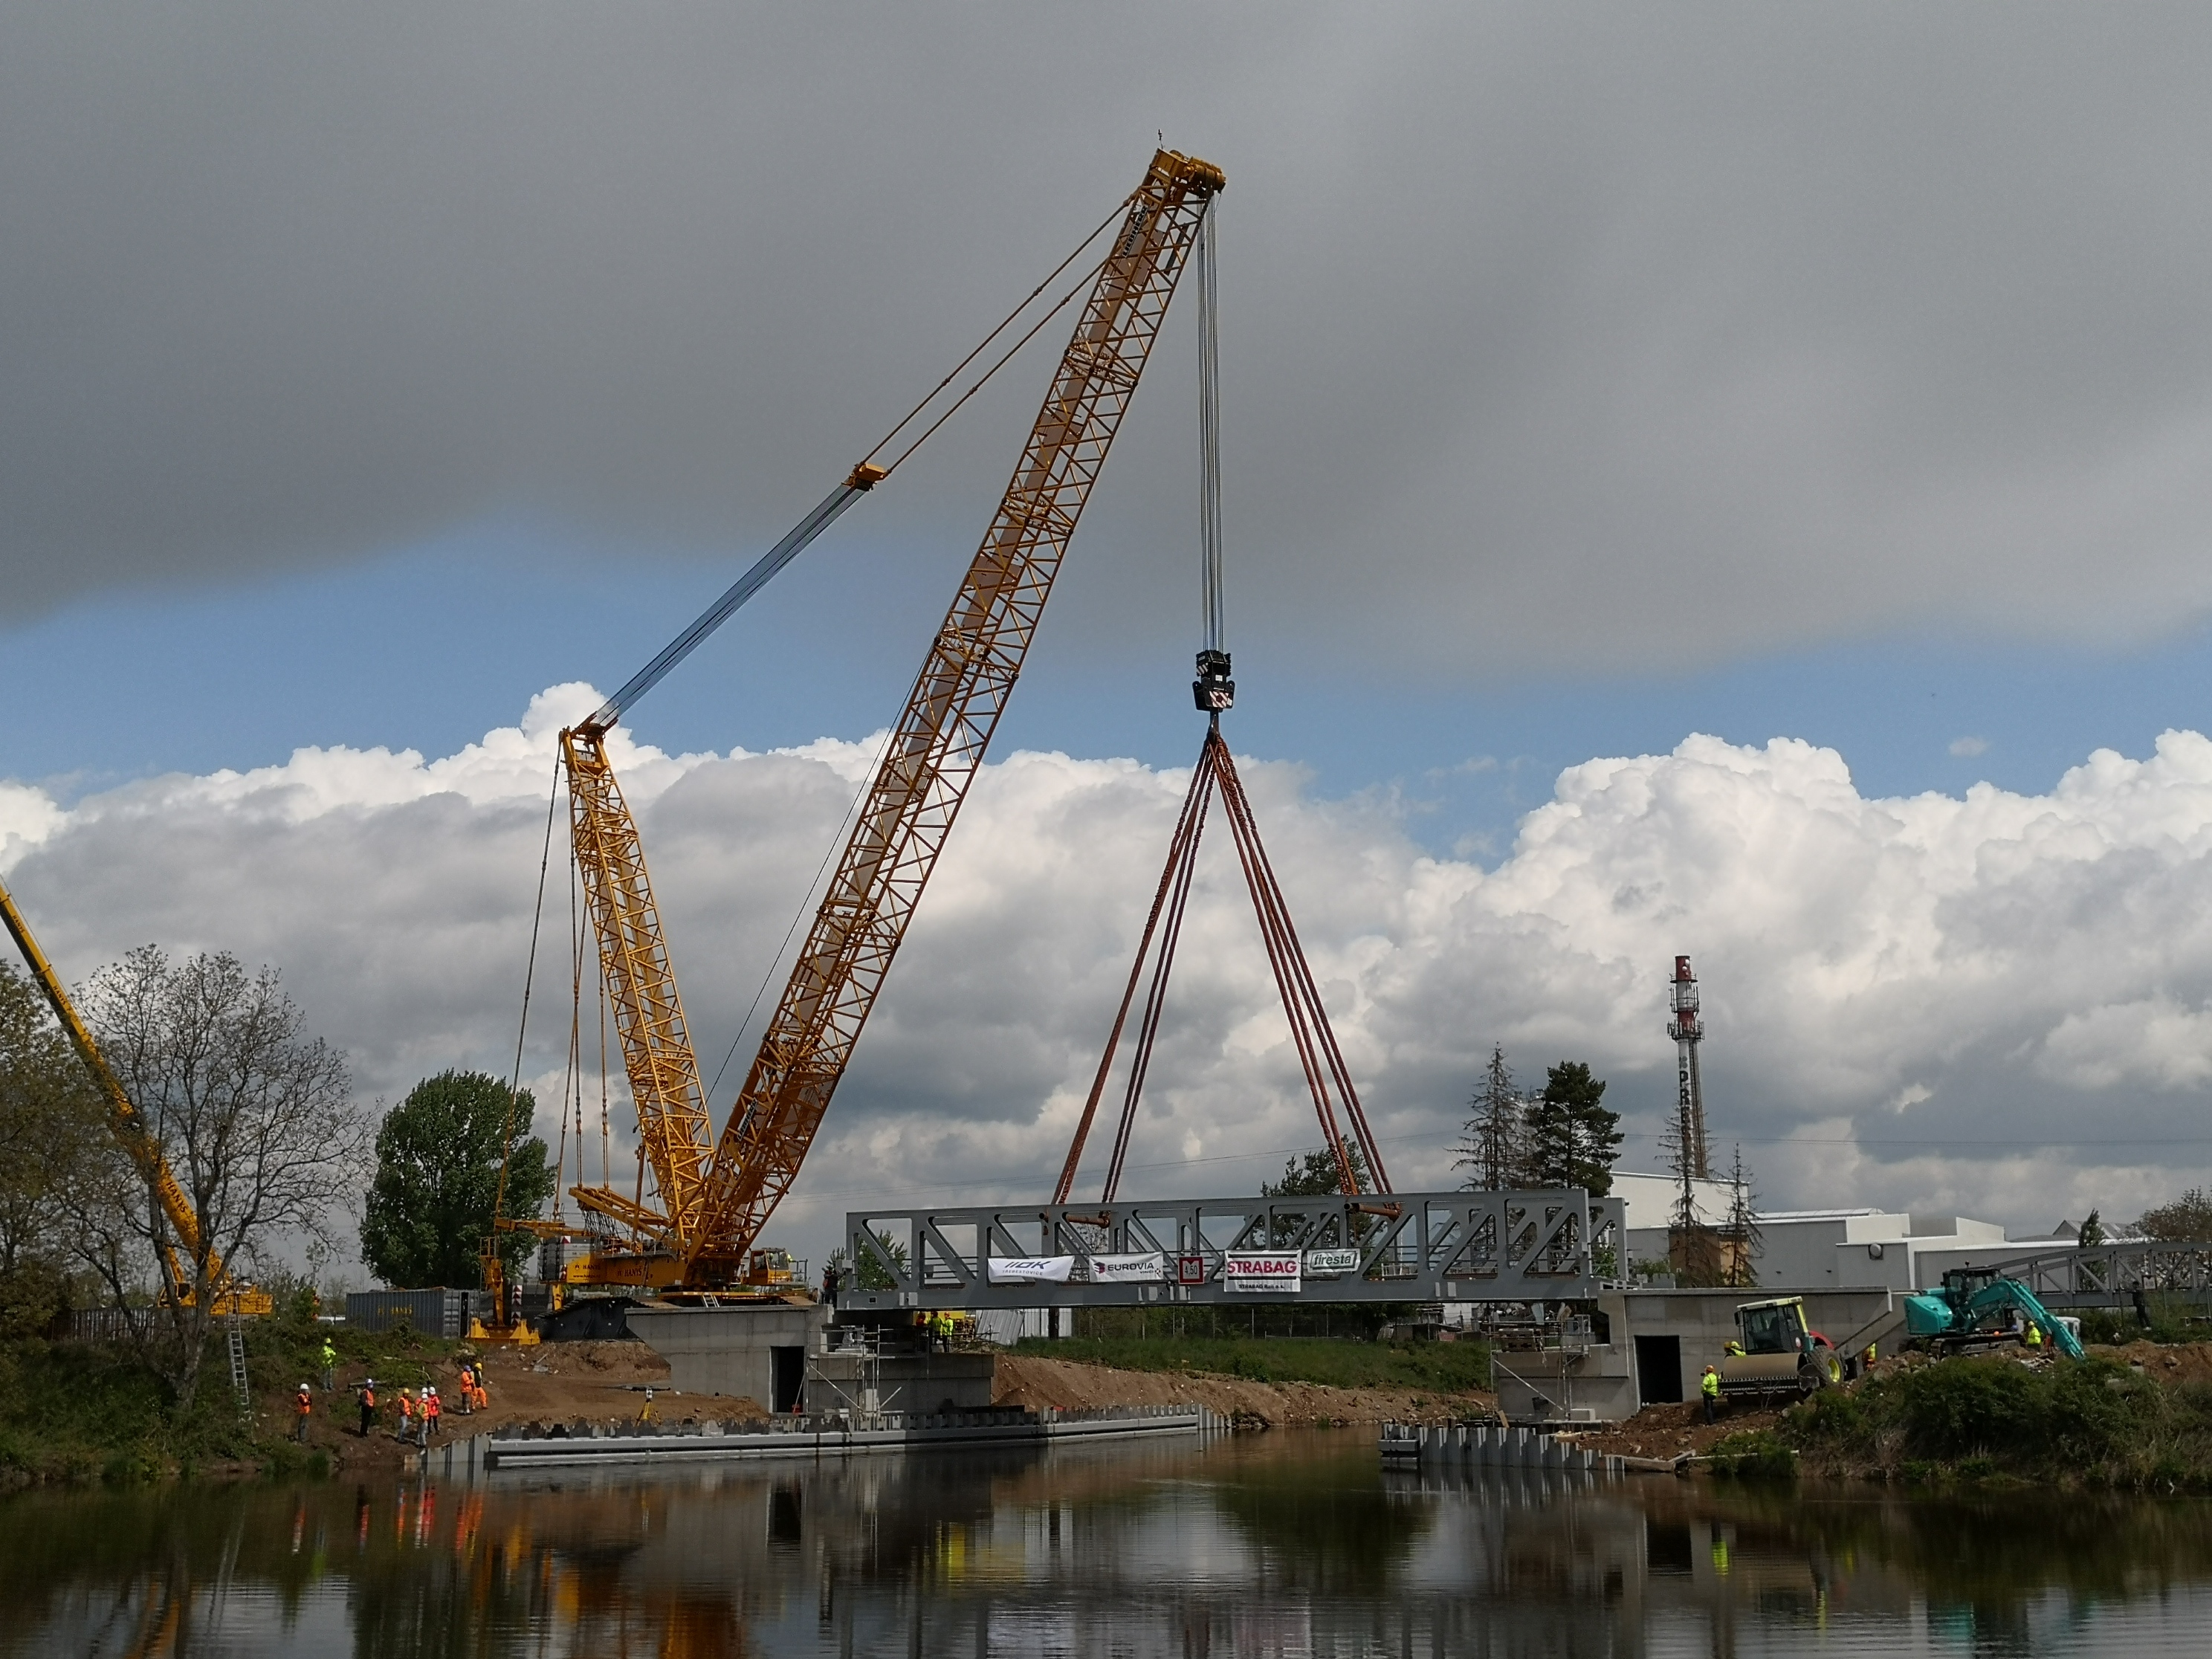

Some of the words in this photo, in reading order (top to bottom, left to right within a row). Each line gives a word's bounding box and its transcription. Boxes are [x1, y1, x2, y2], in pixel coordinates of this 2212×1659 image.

[1122, 205, 1148, 256] LIEBHERR
[737, 1098, 757, 1139] LIEBHERR
[1314, 1254, 1351, 1265] firesta
[1107, 1263, 1154, 1271] EUROVIA
[1227, 1261, 1297, 1273] STRABAG
